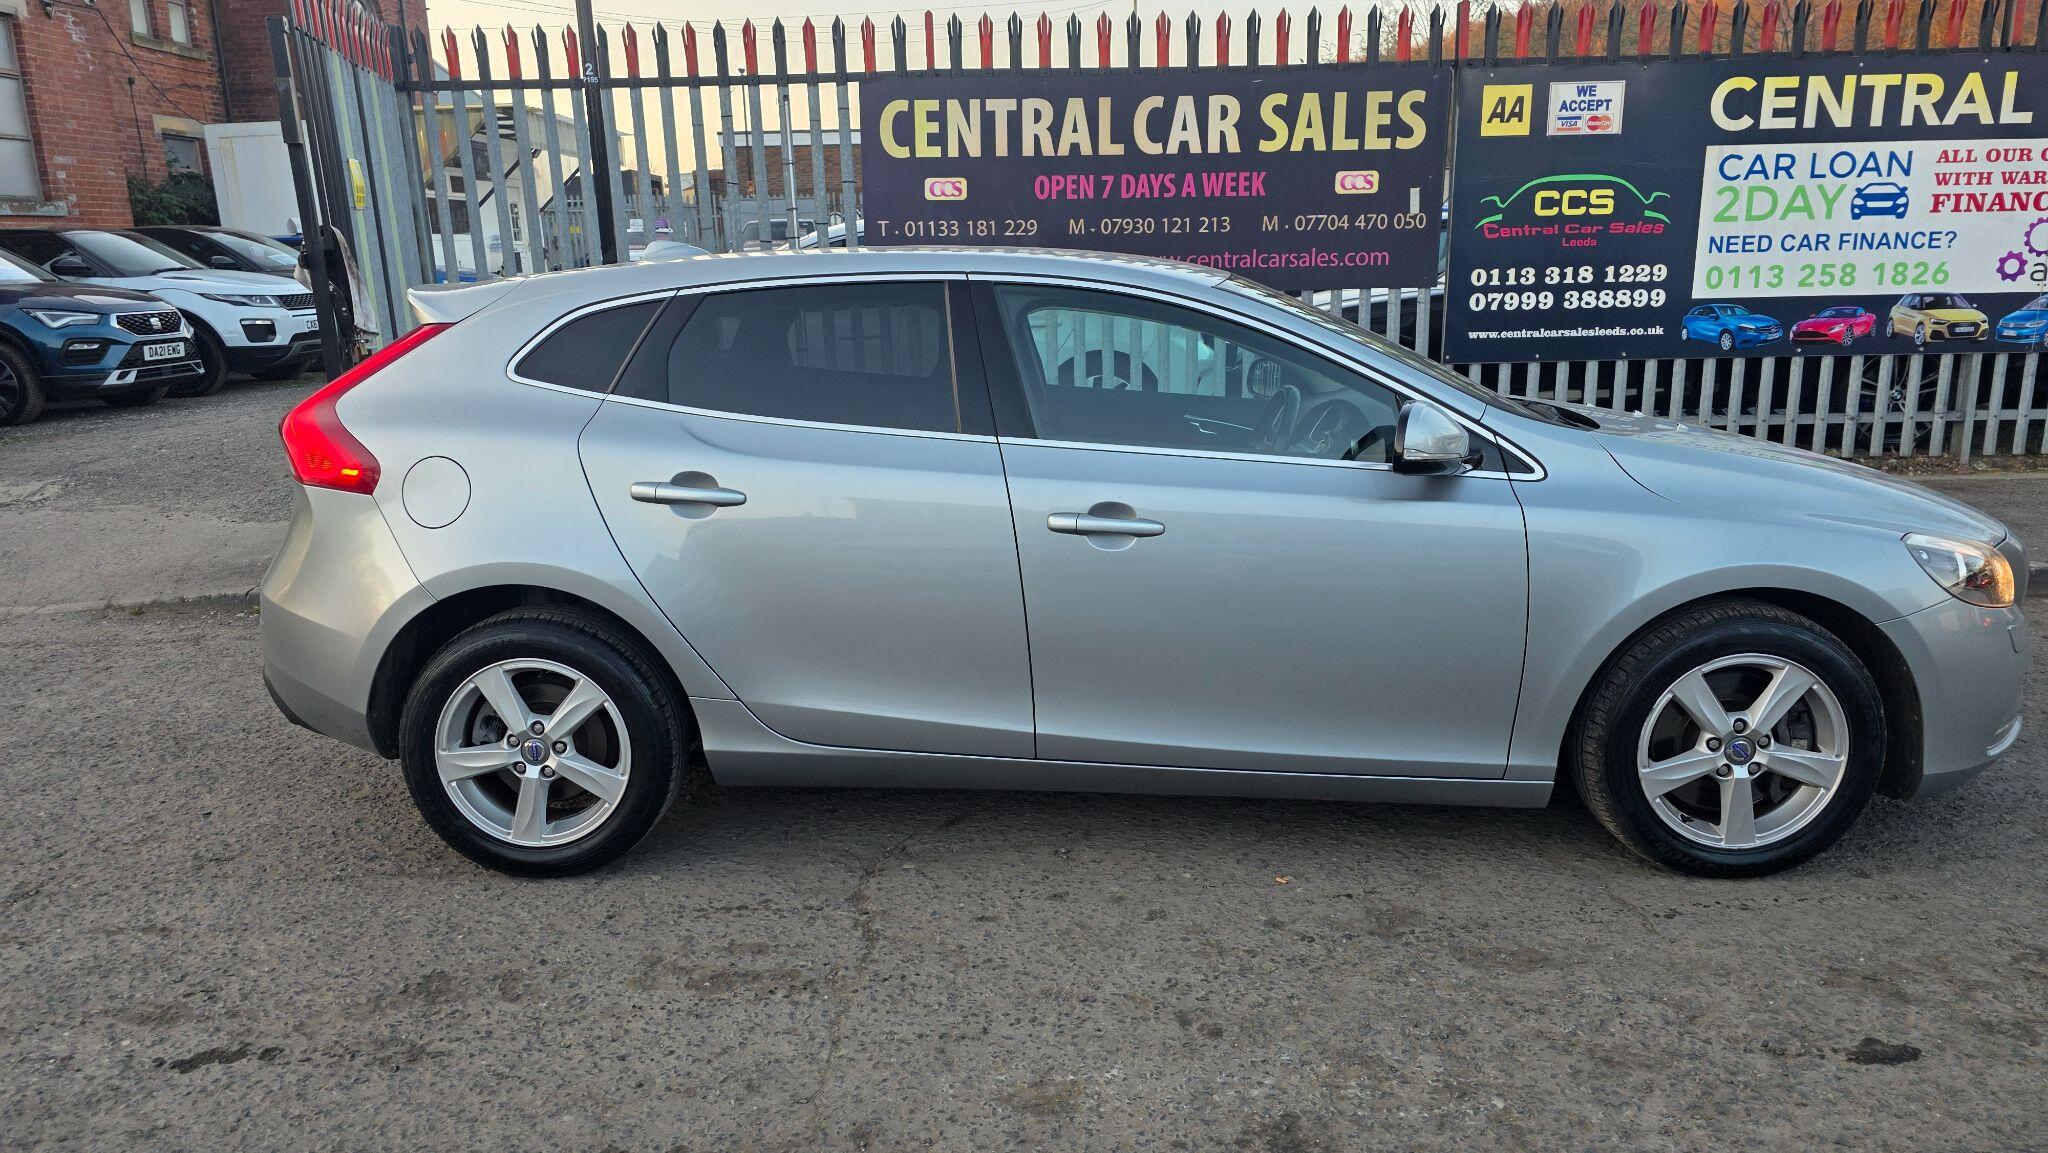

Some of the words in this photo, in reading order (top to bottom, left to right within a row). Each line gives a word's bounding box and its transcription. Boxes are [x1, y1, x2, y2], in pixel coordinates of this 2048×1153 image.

[585, 63, 593, 75] 2
[1577, 85, 1598, 97] WE
[1487, 95, 1525, 124] AA
[1559, 99, 1613, 112] ACCEPT
[1710, 71, 2034, 131] CENTRAL
[880, 97, 1125, 158] CENTRAL
[1132, 94, 1241, 155] CAR
[1258, 90, 1427, 152] SALES
[1936, 149, 1977, 163] ALL
[1985, 148, 2033, 163] OUR
[1718, 152, 1796, 181] CAR
[1809, 150, 1914, 179] LOAN
[1034, 174, 1095, 200] OPEN
[1101, 174, 1115, 199] 7
[1121, 173, 1176, 199] DAYS
[1181, 173, 1197, 198] A
[1202, 171, 1267, 197] WEEK
[1339, 174, 1376, 191] CCS
[1934, 171, 1994, 186] WITH
[929, 181, 962, 197] CCS
[1534, 189, 1615, 216] CCS
[1713, 183, 1847, 223] 2DAY
[904, 219, 960, 237] 01133
[967, 219, 996, 236] 181
[1004, 218, 1038, 236] 229
[1101, 217, 1155, 235] 07930
[1162, 217, 1191, 234] 121
[1199, 216, 1231, 233] 213
[1295, 214, 1350, 231] 07704
[1355, 213, 1388, 230] 470
[1393, 212, 1427, 229] 050
[1483, 223, 1559, 239] Central
[1564, 223, 1603, 235] Car
[1608, 221, 1665, 235] Sales
[1562, 237, 1597, 247] Leeds
[1708, 235, 1773, 254] NEED
[1780, 233, 1830, 252] CAR
[1838, 230, 1958, 251] FINANCE?
[1471, 267, 1536, 287] 0113
[1544, 265, 1594, 285] 318
[1604, 263, 1668, 283] 1229
[1706, 264, 1785, 290] 0113
[1797, 261, 1857, 288] 258
[1872, 260, 1951, 286] 1826
[1469, 291, 1554, 311] 07999
[1563, 288, 1667, 310] 388899
[1468, 326, 1665, 339] www.centralcarsalesleeds.co.uk
[148, 345, 166, 358] DA21
